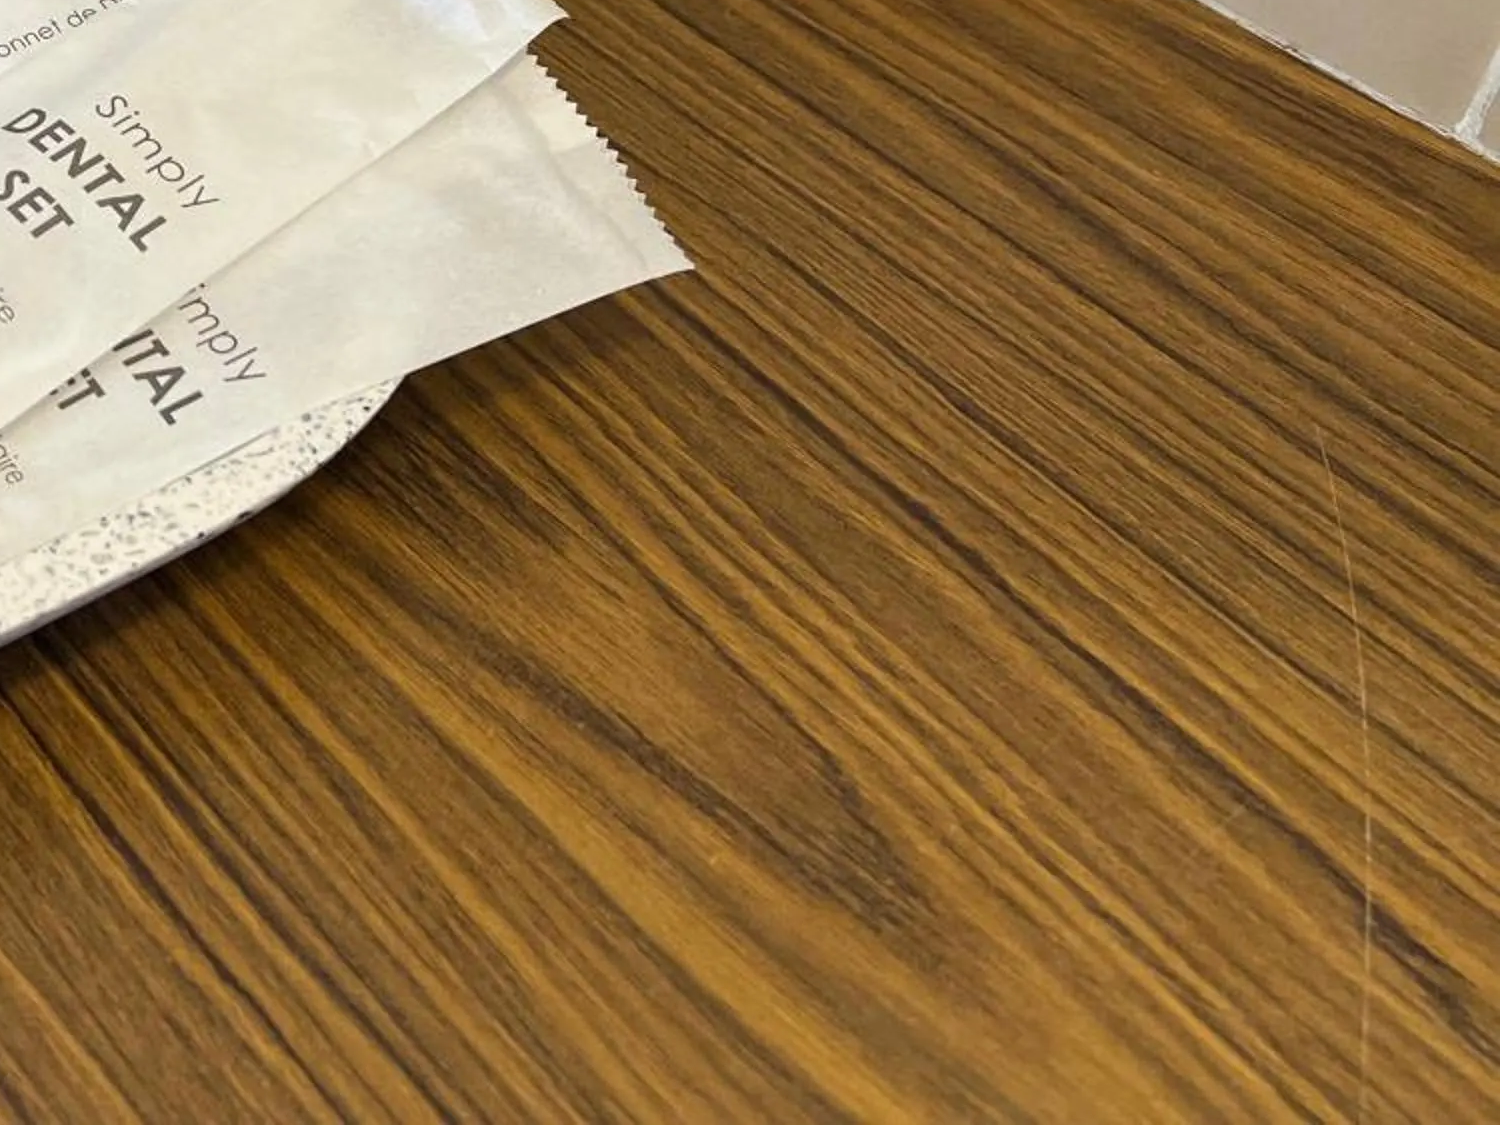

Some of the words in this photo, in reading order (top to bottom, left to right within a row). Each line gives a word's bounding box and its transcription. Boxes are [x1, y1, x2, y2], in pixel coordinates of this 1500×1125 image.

[1, 107, 168, 252] DENTAL
[96, 95, 221, 210] Simply
[178, 283, 267, 382] imply
